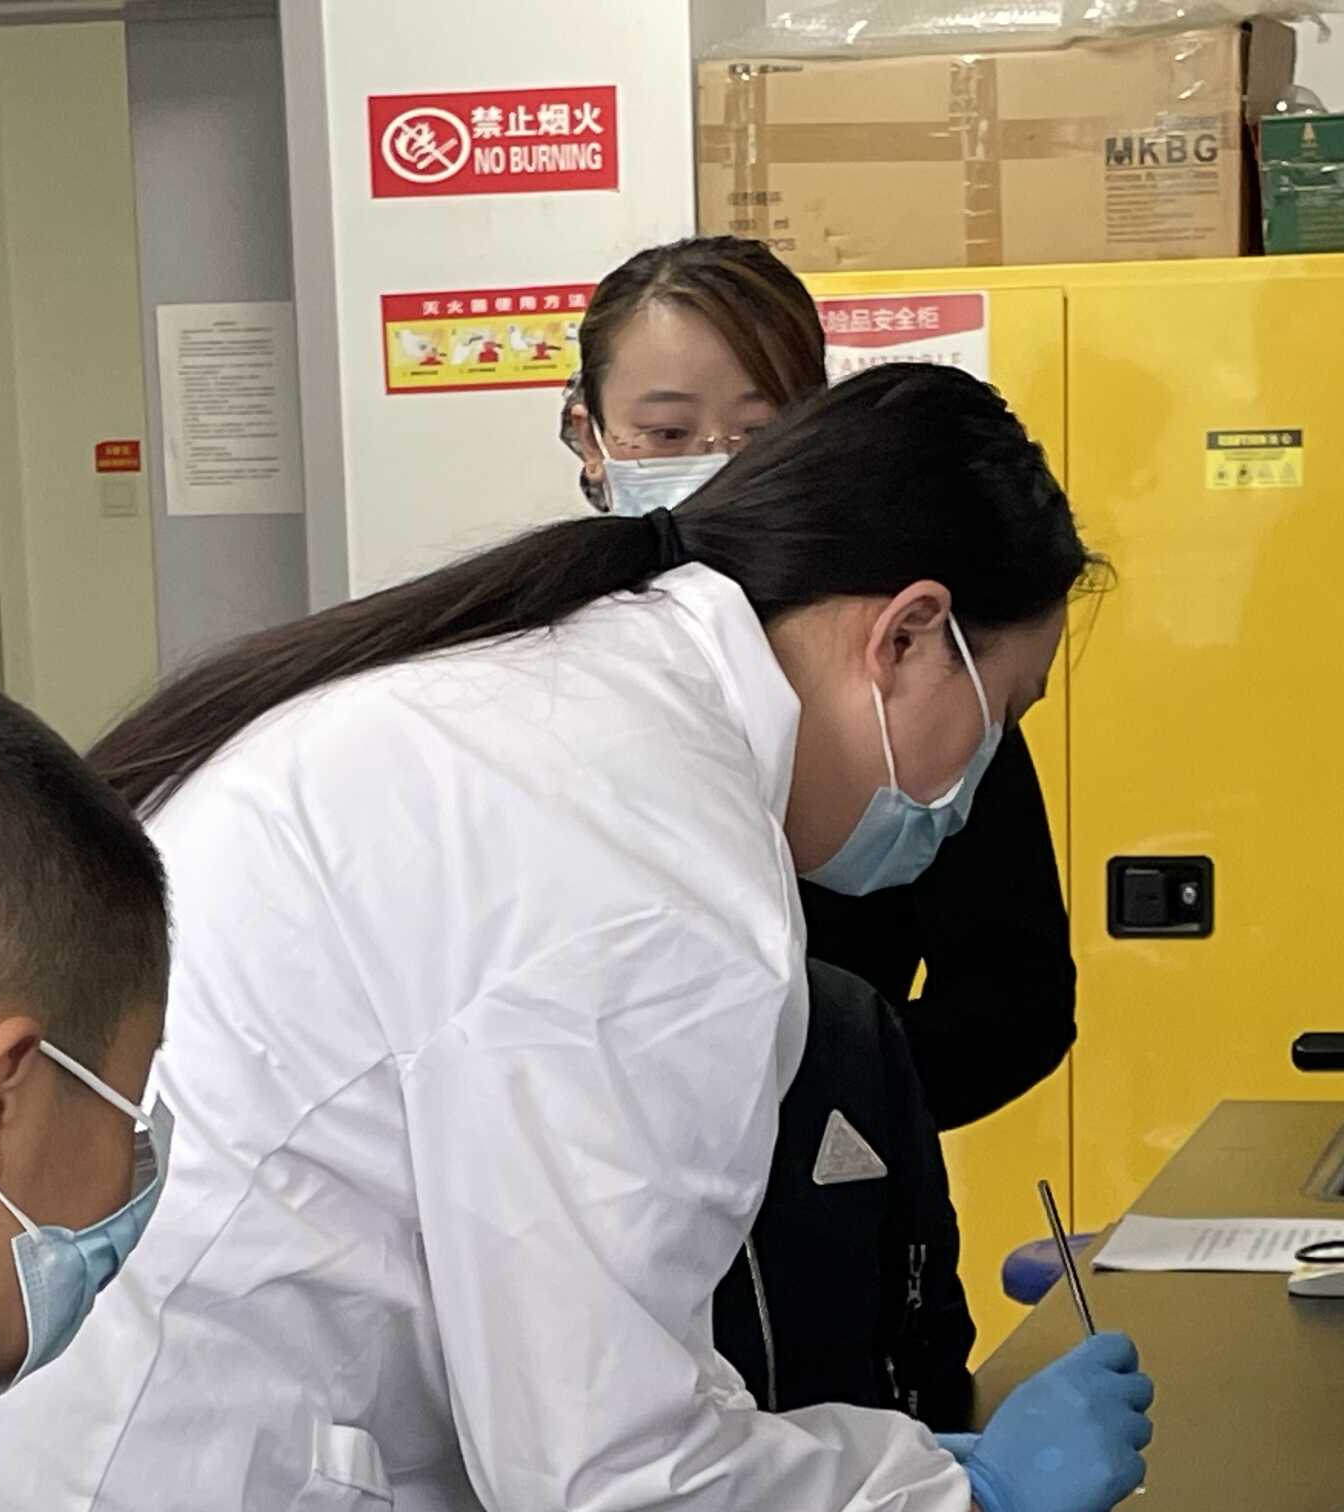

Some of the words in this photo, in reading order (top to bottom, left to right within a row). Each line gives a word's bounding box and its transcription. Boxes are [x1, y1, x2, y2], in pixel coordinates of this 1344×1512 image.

[471, 103, 603, 138] 禁止烟火
[474, 147, 503, 174] NO
[509, 143, 602, 172] BURNING
[422, 293, 587, 316] 灭火器使用方法
[822, 306, 940, 333] 险品安全柜
